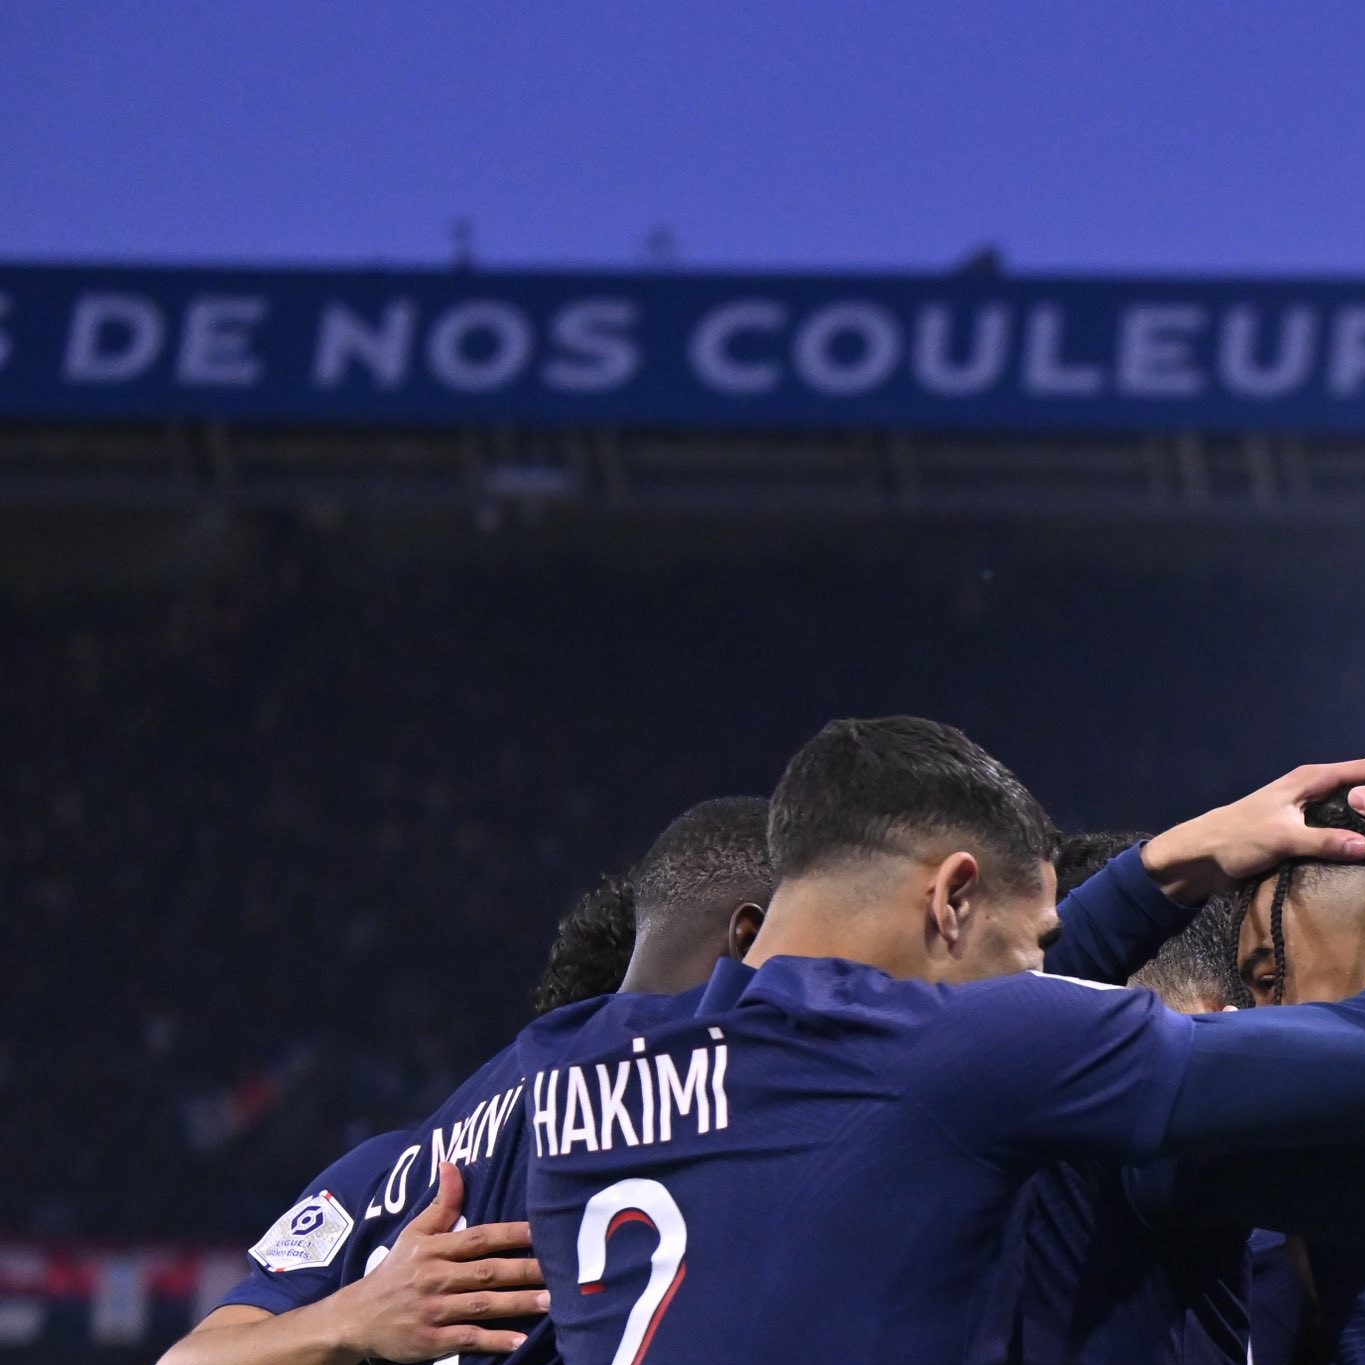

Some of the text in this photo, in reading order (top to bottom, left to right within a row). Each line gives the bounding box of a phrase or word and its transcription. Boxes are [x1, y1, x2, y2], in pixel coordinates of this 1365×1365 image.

[62, 292, 267, 384] DE
[312, 298, 642, 392] NOS
[276, 1238, 304, 1248] LIGUE
[286, 1248, 310, 1259] Eats
